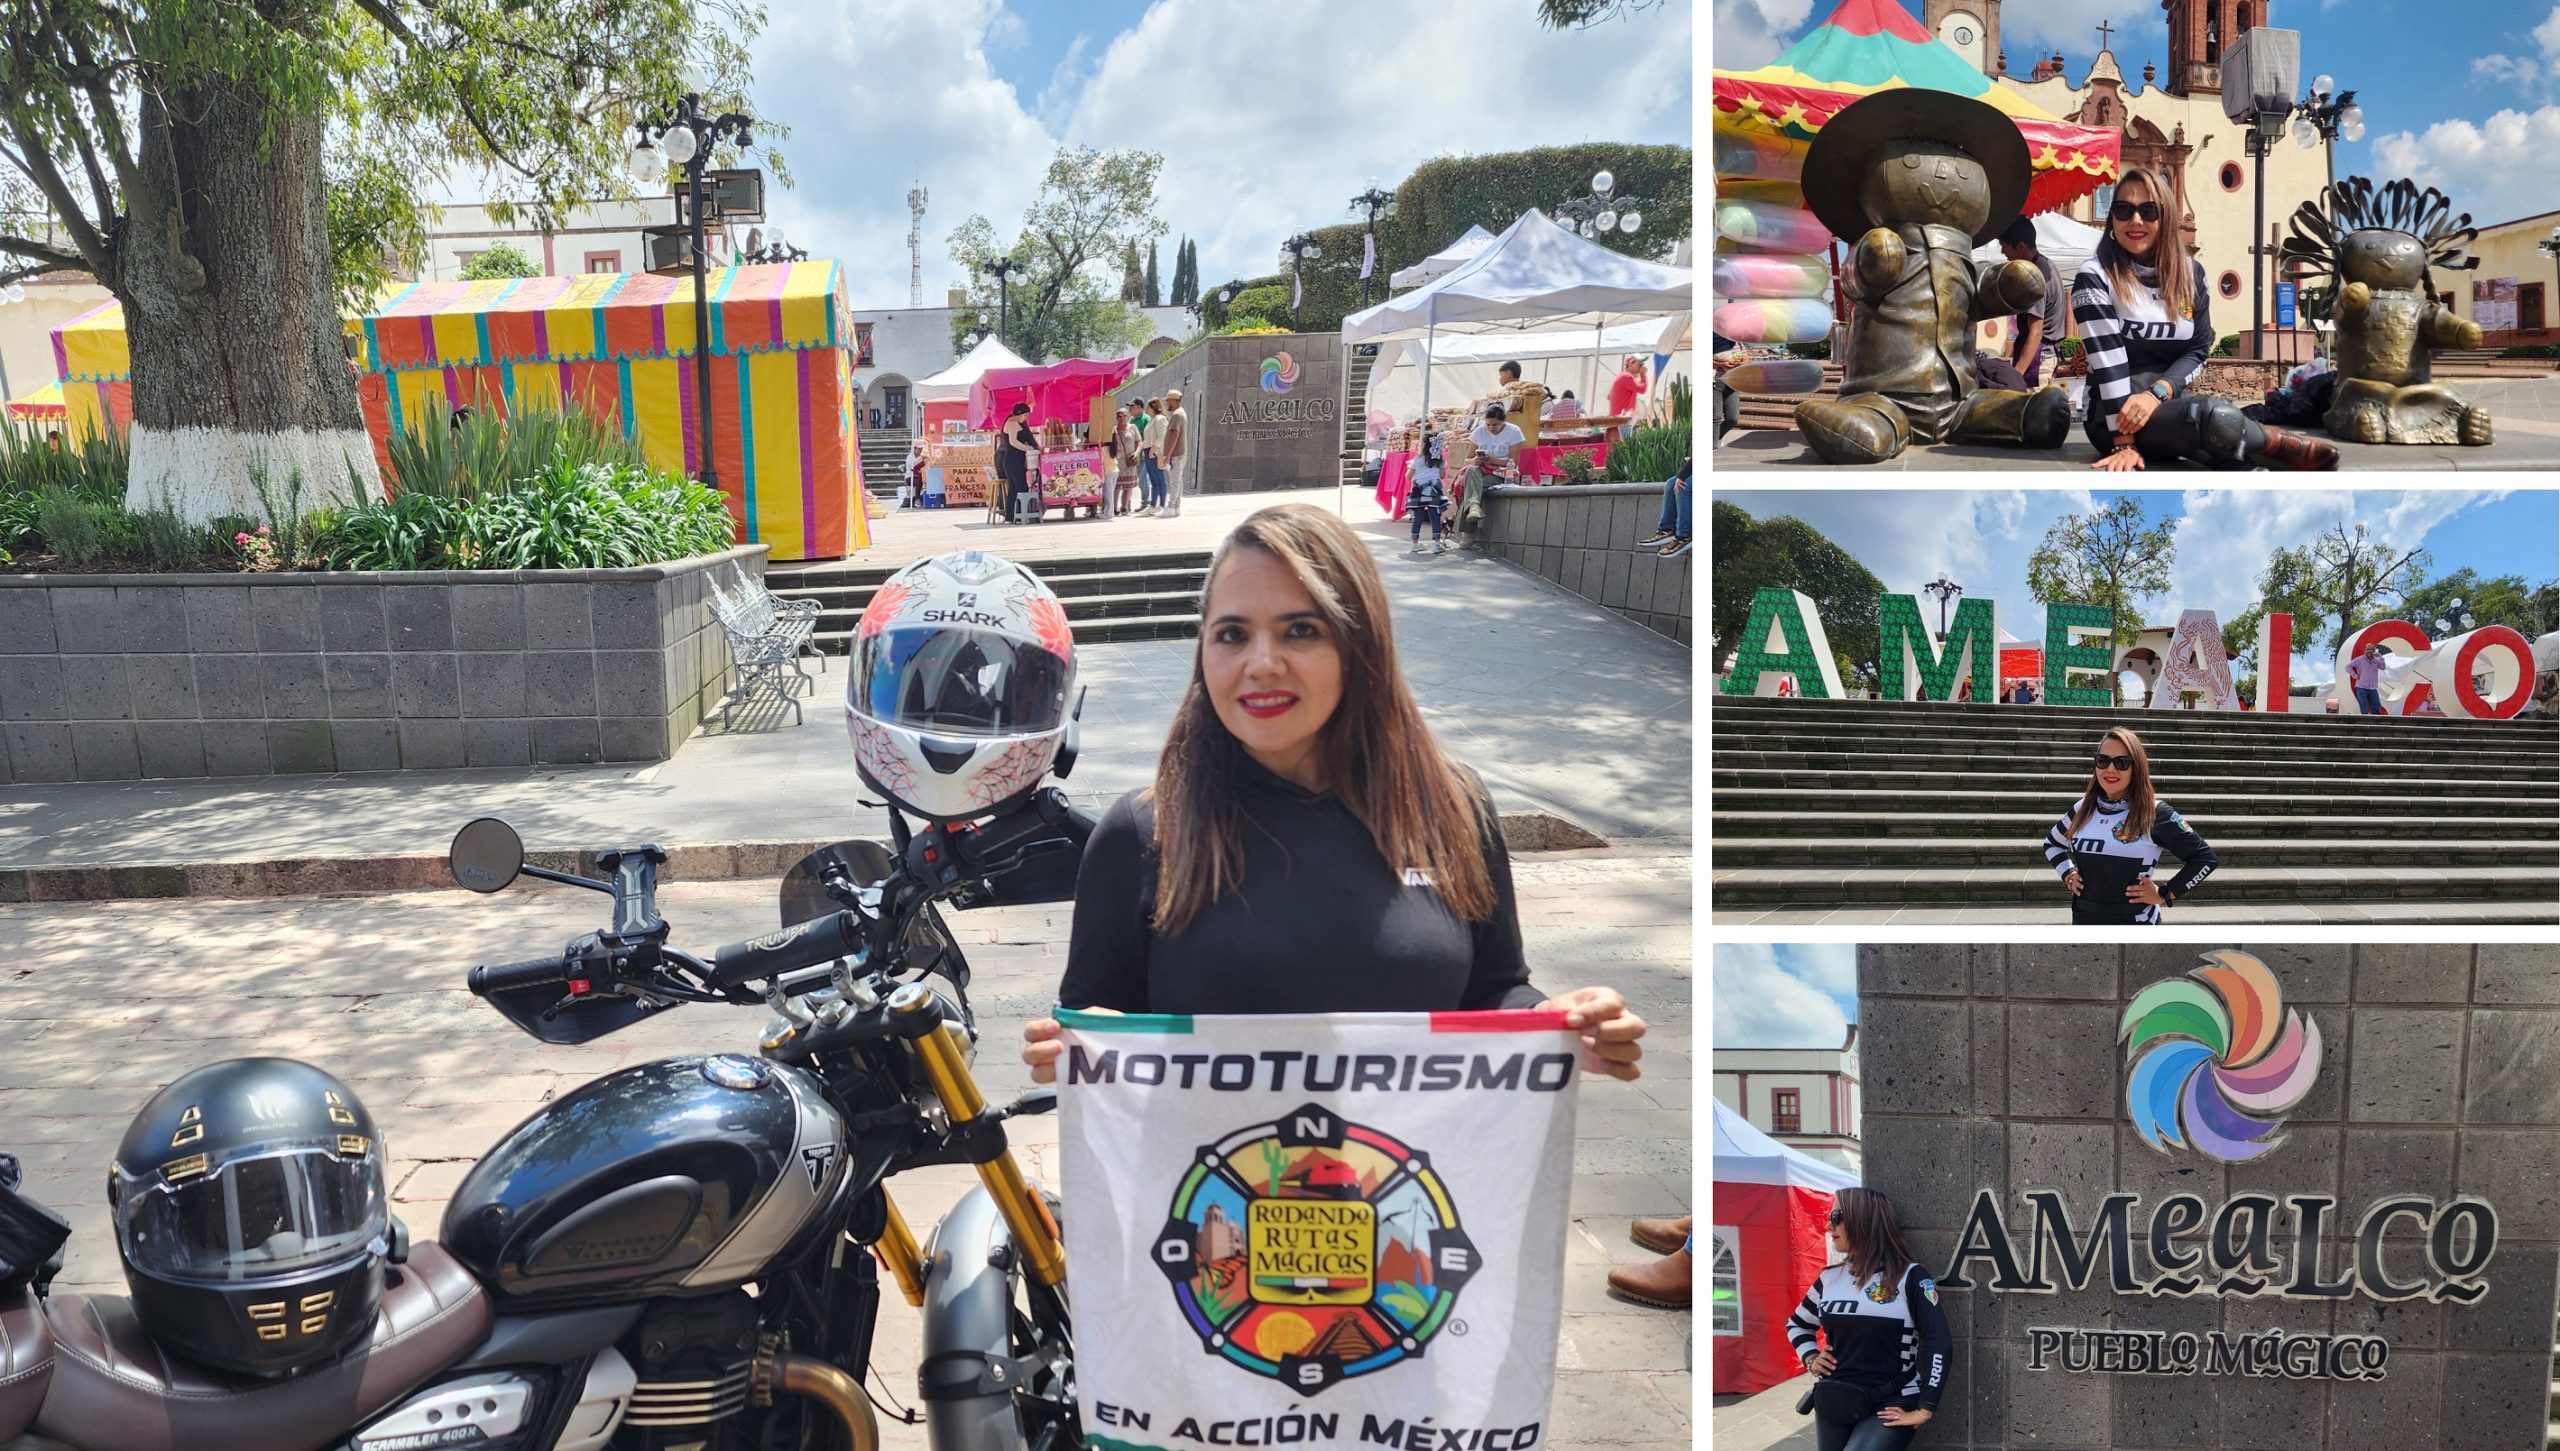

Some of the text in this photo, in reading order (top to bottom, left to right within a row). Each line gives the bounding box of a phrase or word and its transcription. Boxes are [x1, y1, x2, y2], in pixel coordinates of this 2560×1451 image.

[1053, 461, 1089, 471] LELERO
[945, 483, 986, 492] FRANCESA
[965, 475, 976, 483] LA
[958, 491, 983, 499] FRITAS
[923, 609, 1007, 630] SHARK
[2185, 864, 2211, 890] RRM
[744, 922, 810, 952] TRIUMPH
[1067, 1045, 1575, 1092] MOTOTURISMO
[1296, 1116, 1329, 1139] N
[1440, 1247, 1468, 1271] E
[1299, 1364, 1324, 1384] S
[1928, 1353, 1943, 1388] RRM
[1096, 1401, 1540, 1451] EN ACCIÓN MÉXICO
[361, 1425, 477, 1451] SCRAMBLER 400X
